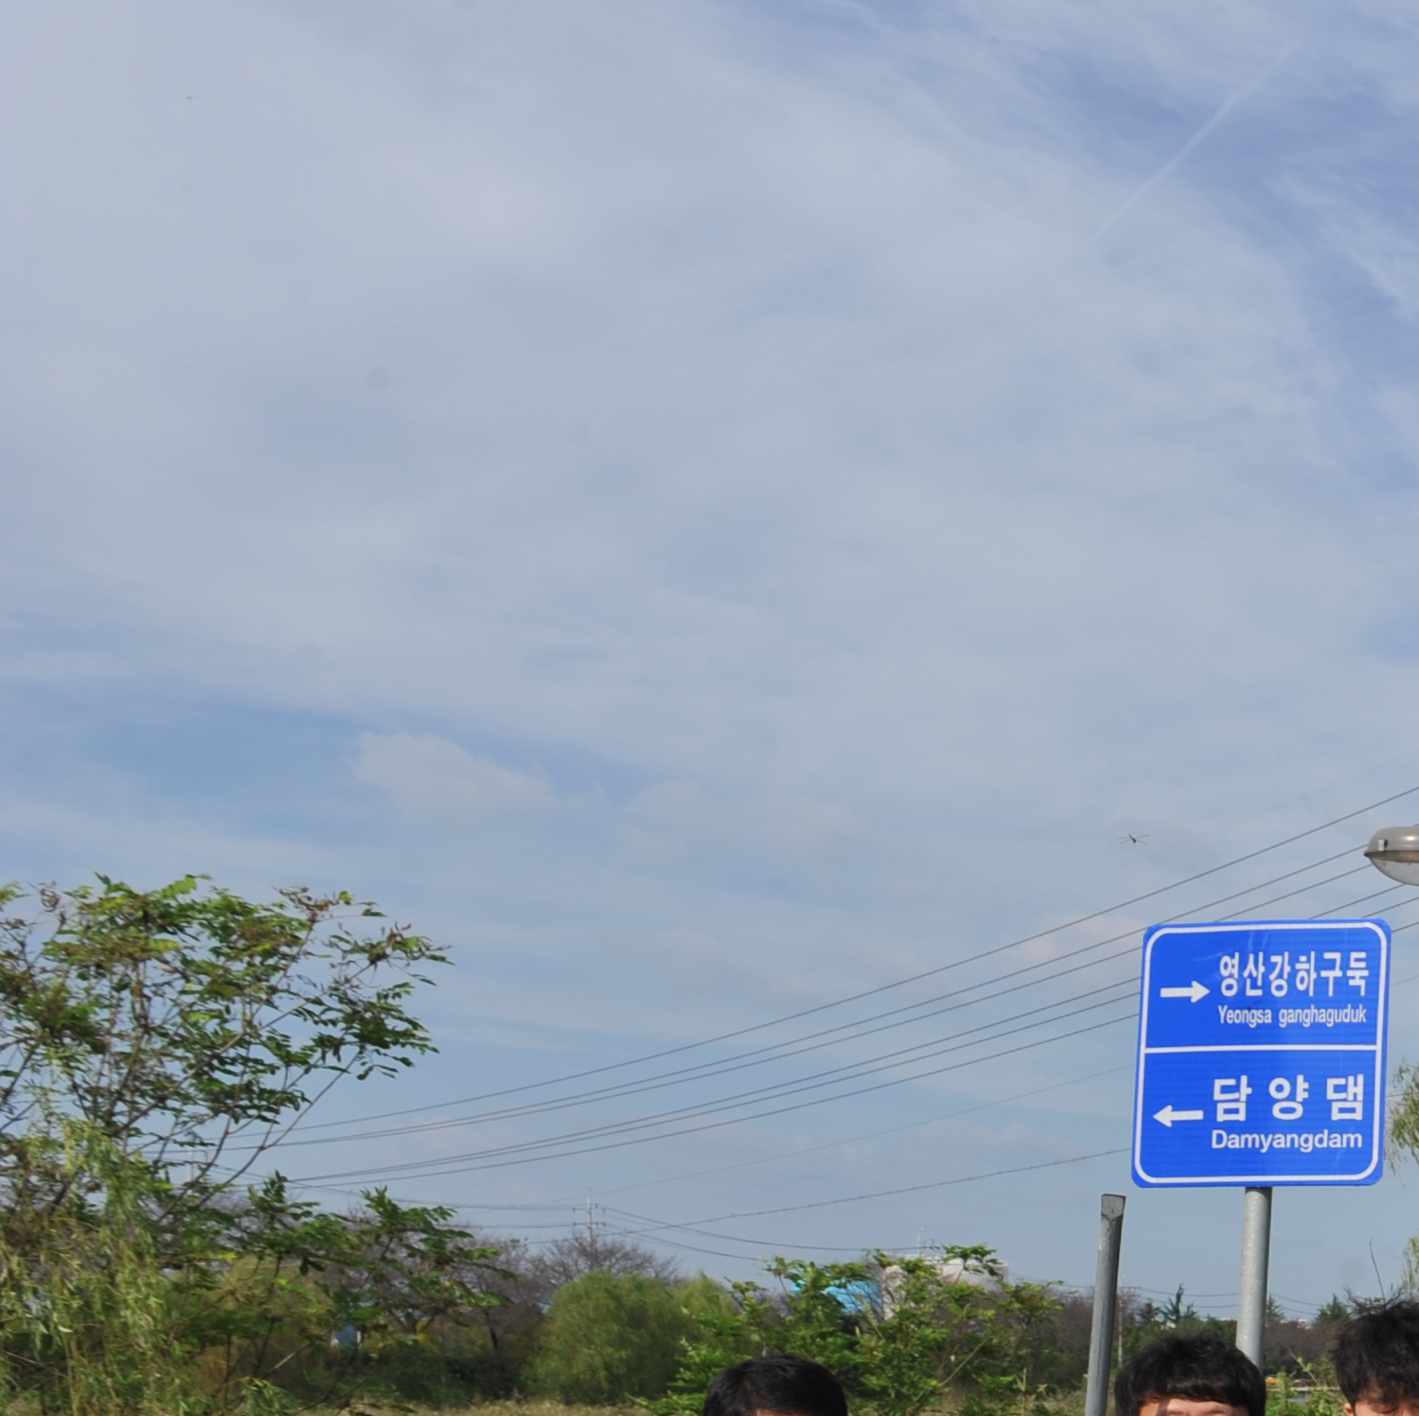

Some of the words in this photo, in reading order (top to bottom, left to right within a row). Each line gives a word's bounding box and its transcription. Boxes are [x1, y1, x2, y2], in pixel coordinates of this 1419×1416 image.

[1219, 951, 1369, 997] 영산강하구둑
[1218, 1005, 1272, 1028] Yeongsa
[1278, 1004, 1367, 1028] ganghaguduk
[1211, 1129, 1363, 1153] Damyangdam
